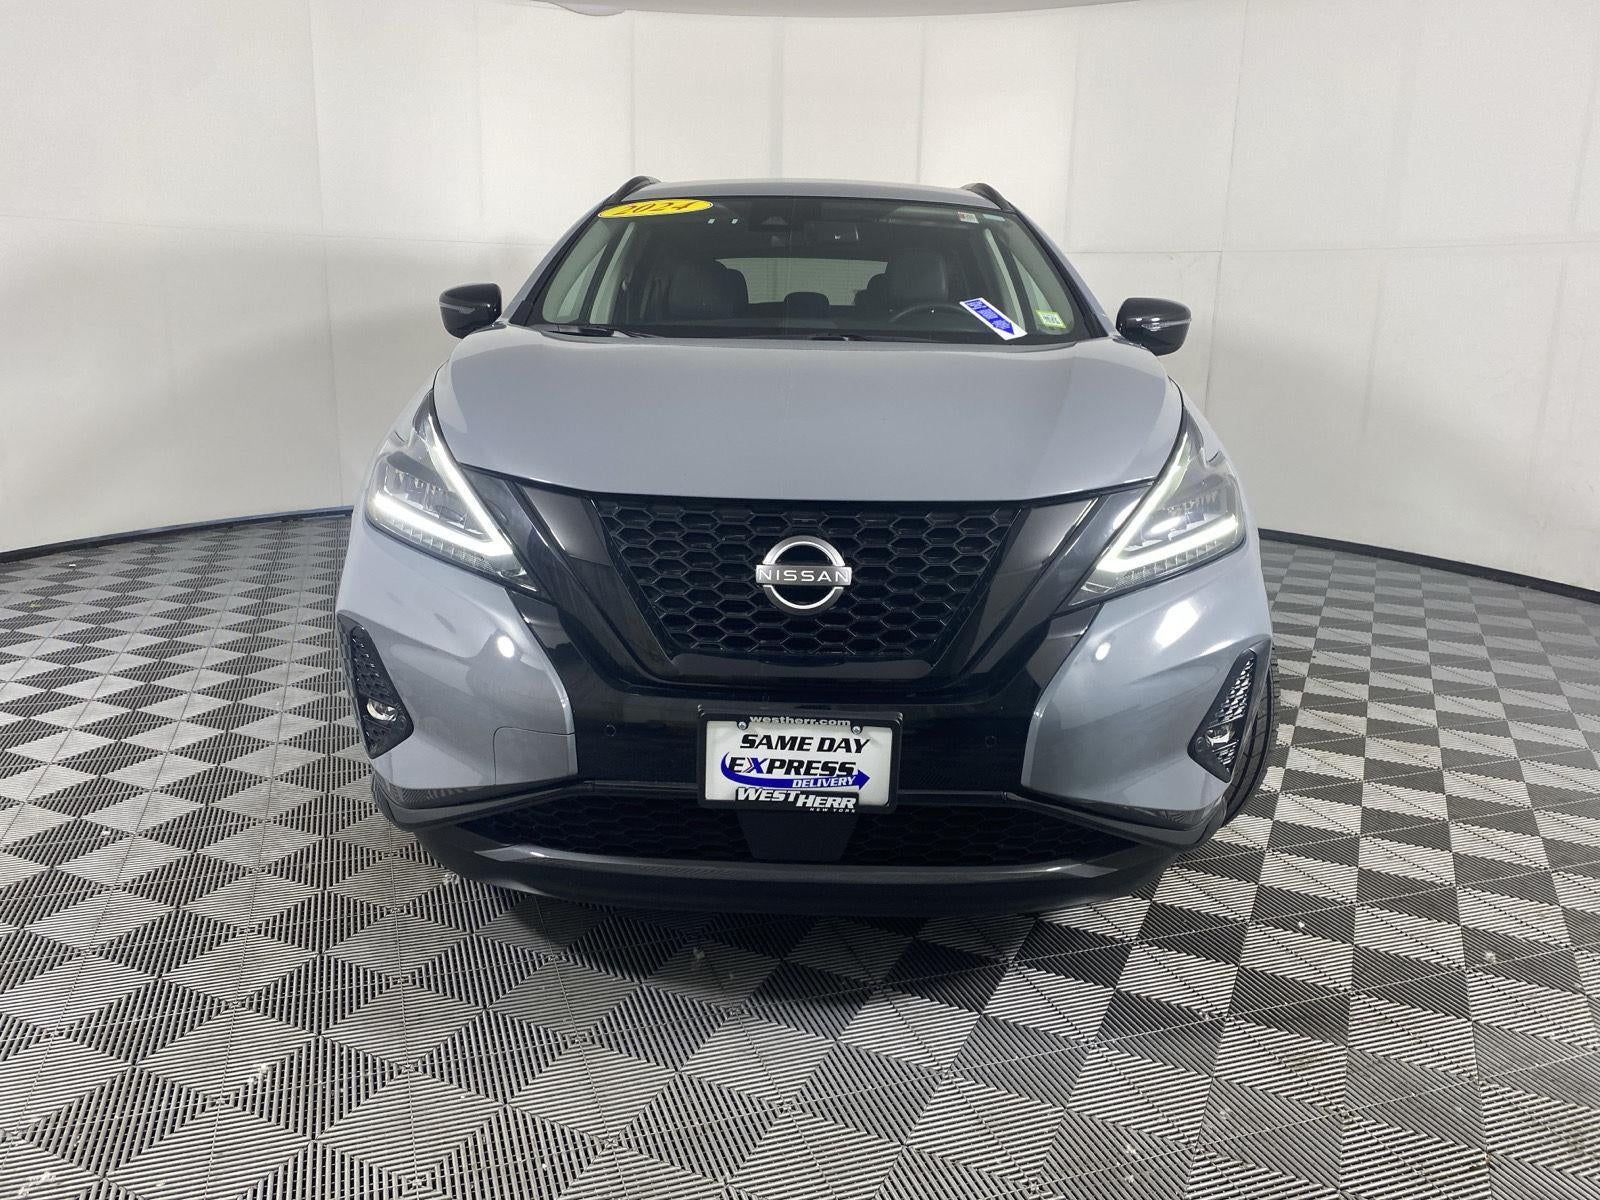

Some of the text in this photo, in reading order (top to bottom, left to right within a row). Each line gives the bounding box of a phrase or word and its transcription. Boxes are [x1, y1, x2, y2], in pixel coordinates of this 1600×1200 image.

[613, 201, 698, 215] 2024
[759, 568, 849, 582] NISSAN
[749, 716, 851, 726] westherr.com
[740, 733, 870, 754] SAME DAY
[728, 756, 857, 777] EXPRESS
[792, 776, 856, 788] DELIVERY
